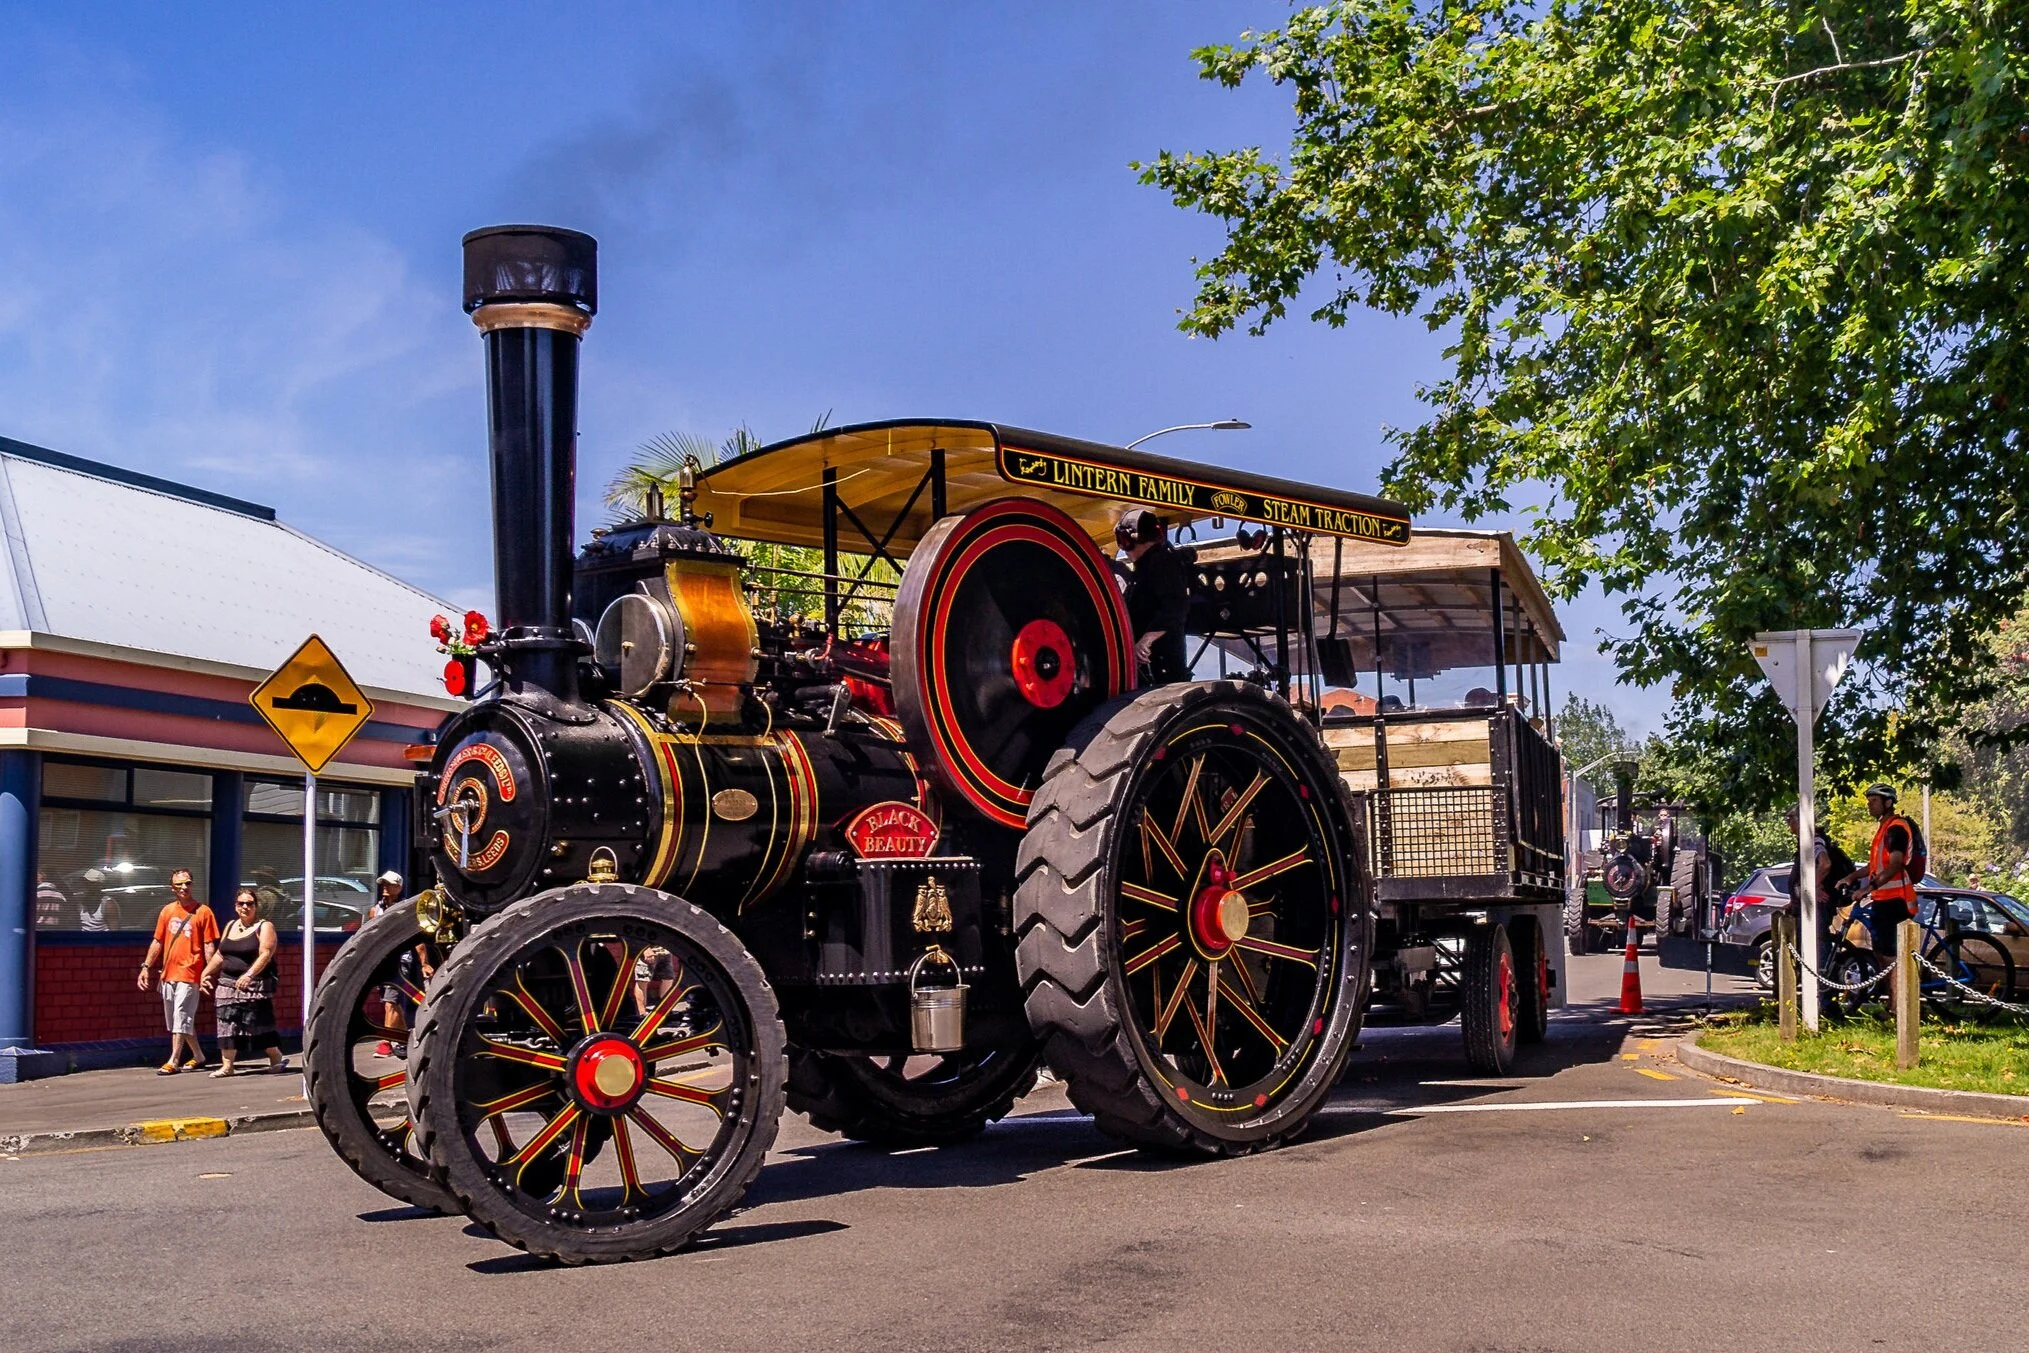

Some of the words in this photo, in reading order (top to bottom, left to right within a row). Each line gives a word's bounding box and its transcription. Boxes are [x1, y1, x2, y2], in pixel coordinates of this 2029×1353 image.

[1053, 460, 1131, 495] LINTERN
[1139, 476, 1195, 506] FAMILY
[1213, 493, 1245, 512] FOWLER
[1263, 499, 1310, 526] STEAM
[1315, 508, 1380, 537] TRACTION
[485, 751, 509, 780] (LEEDS)
[865, 809, 921, 834] BLACK
[481, 837, 505, 864] LEEDS
[864, 836, 927, 853] BEAUTY
